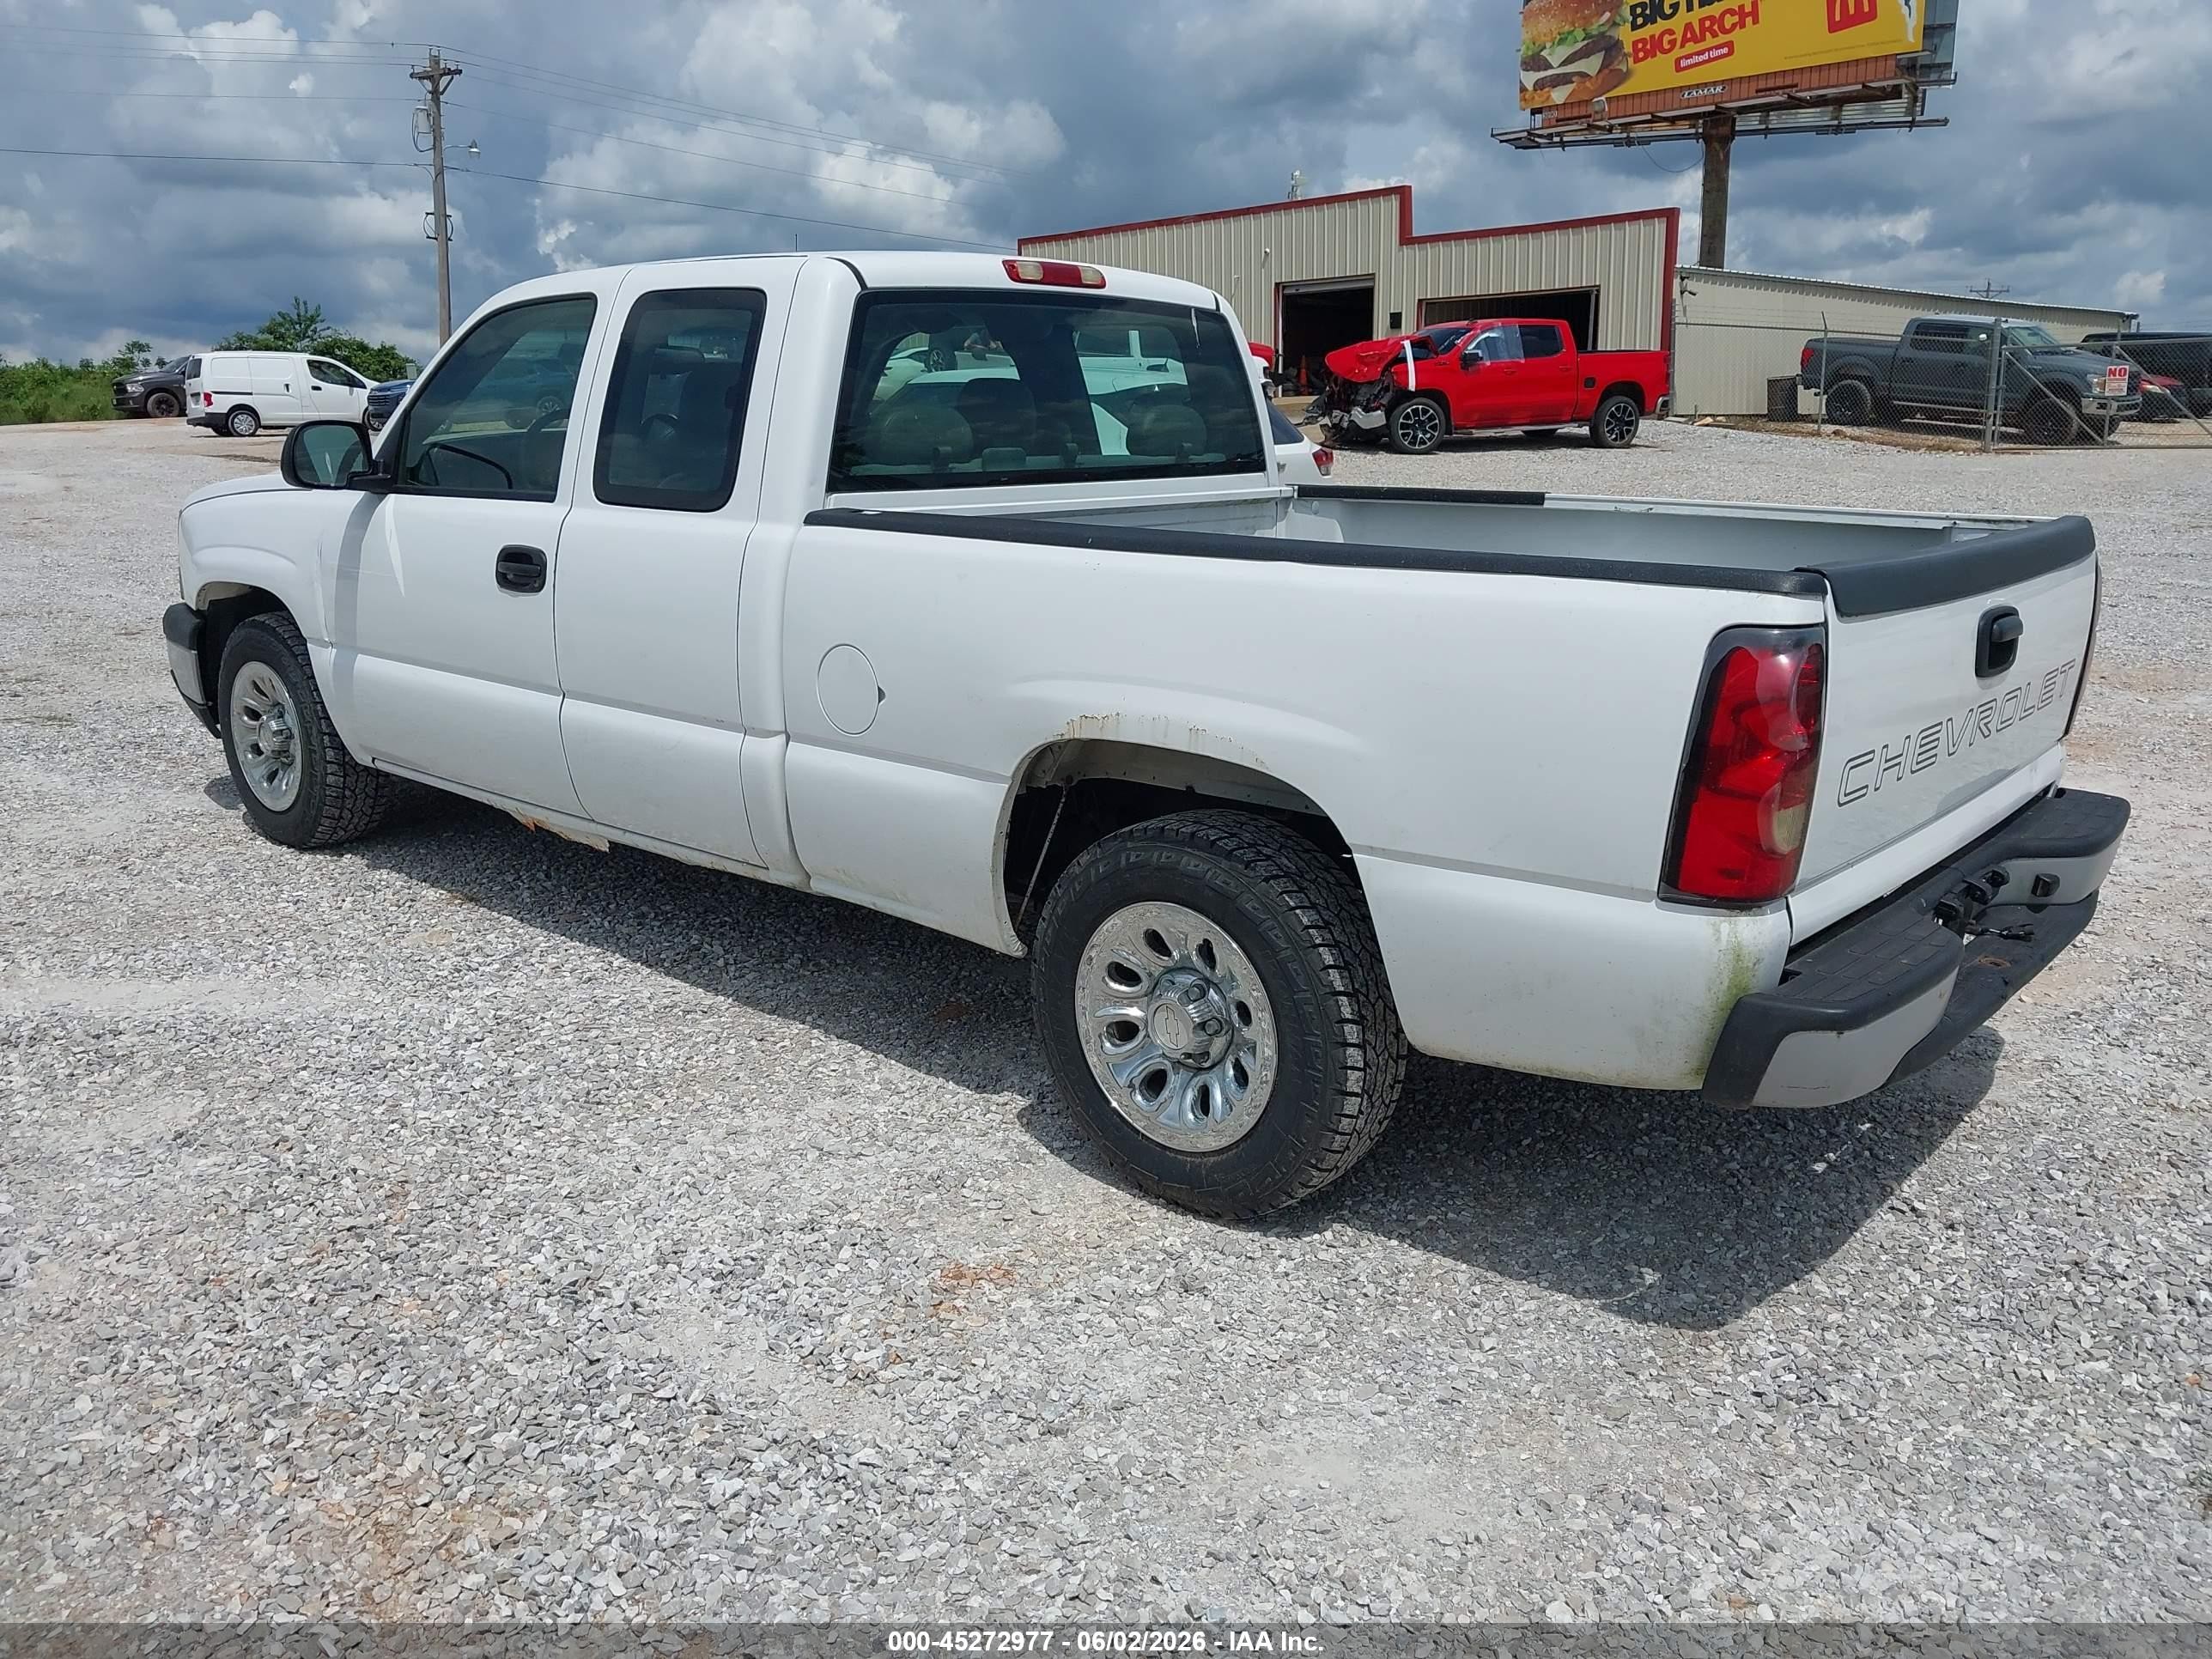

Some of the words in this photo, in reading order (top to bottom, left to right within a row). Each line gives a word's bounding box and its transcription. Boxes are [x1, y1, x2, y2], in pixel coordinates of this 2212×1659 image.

[1629, 0, 1680, 32] BIG
[1632, 27, 1678, 64] BIG
[1679, 0, 1759, 50] ARCH
[1680, 52, 1709, 69] limited
[1710, 46, 1729, 58] time
[1683, 85, 1724, 99] LAMAR
[2107, 367, 2128, 378] NO
[1837, 658, 2076, 808] CHEVROLET
